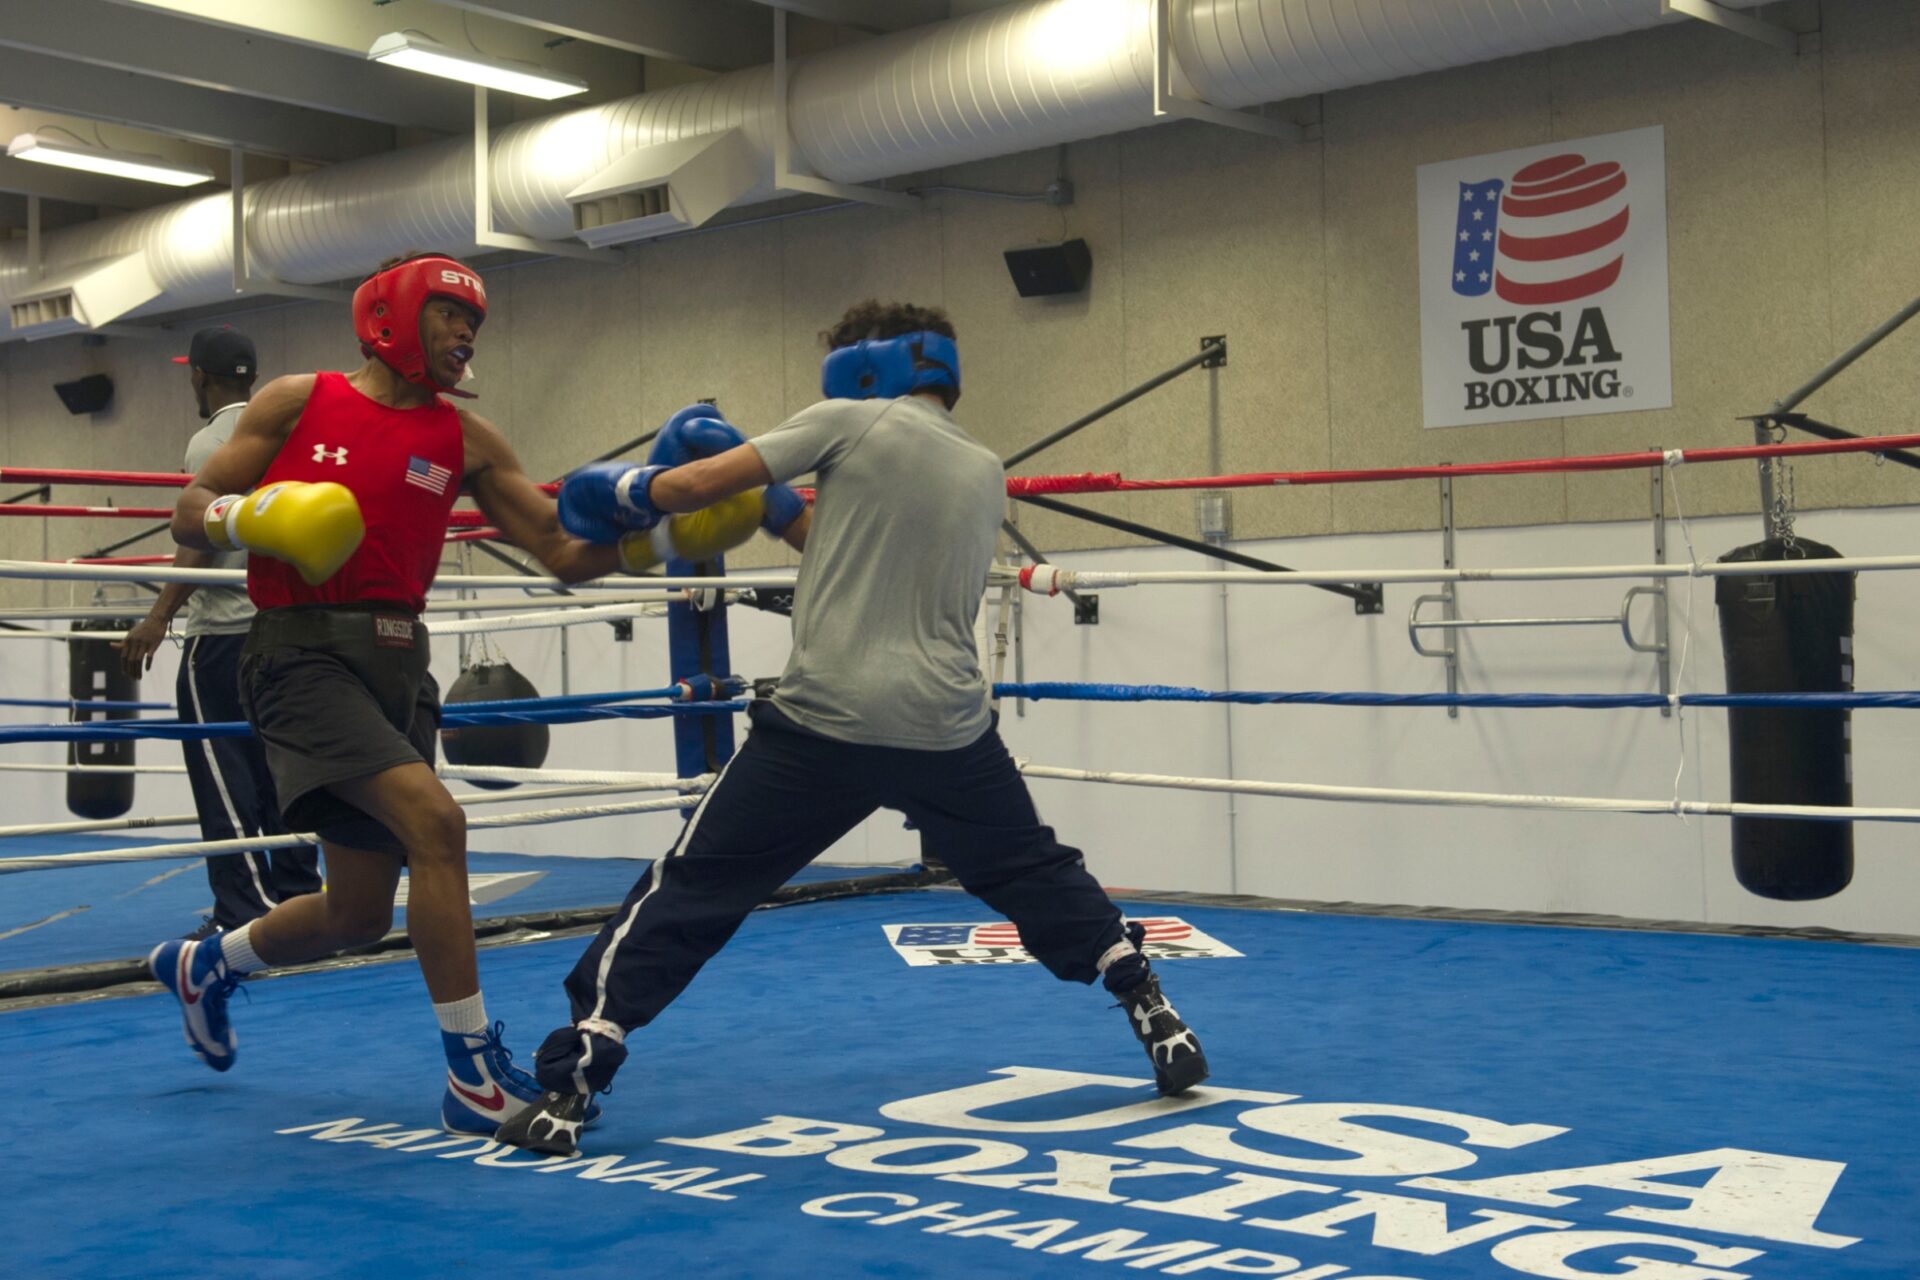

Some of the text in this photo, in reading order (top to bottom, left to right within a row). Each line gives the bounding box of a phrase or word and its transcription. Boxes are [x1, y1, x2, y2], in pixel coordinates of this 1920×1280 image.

[1461, 306, 1622, 374] USA
[915, 942, 1212, 959] UA
[656, 1115, 1766, 1280] BOXING
[878, 1066, 1864, 1249] USA
[800, 1192, 1426, 1280] CHAMPI
